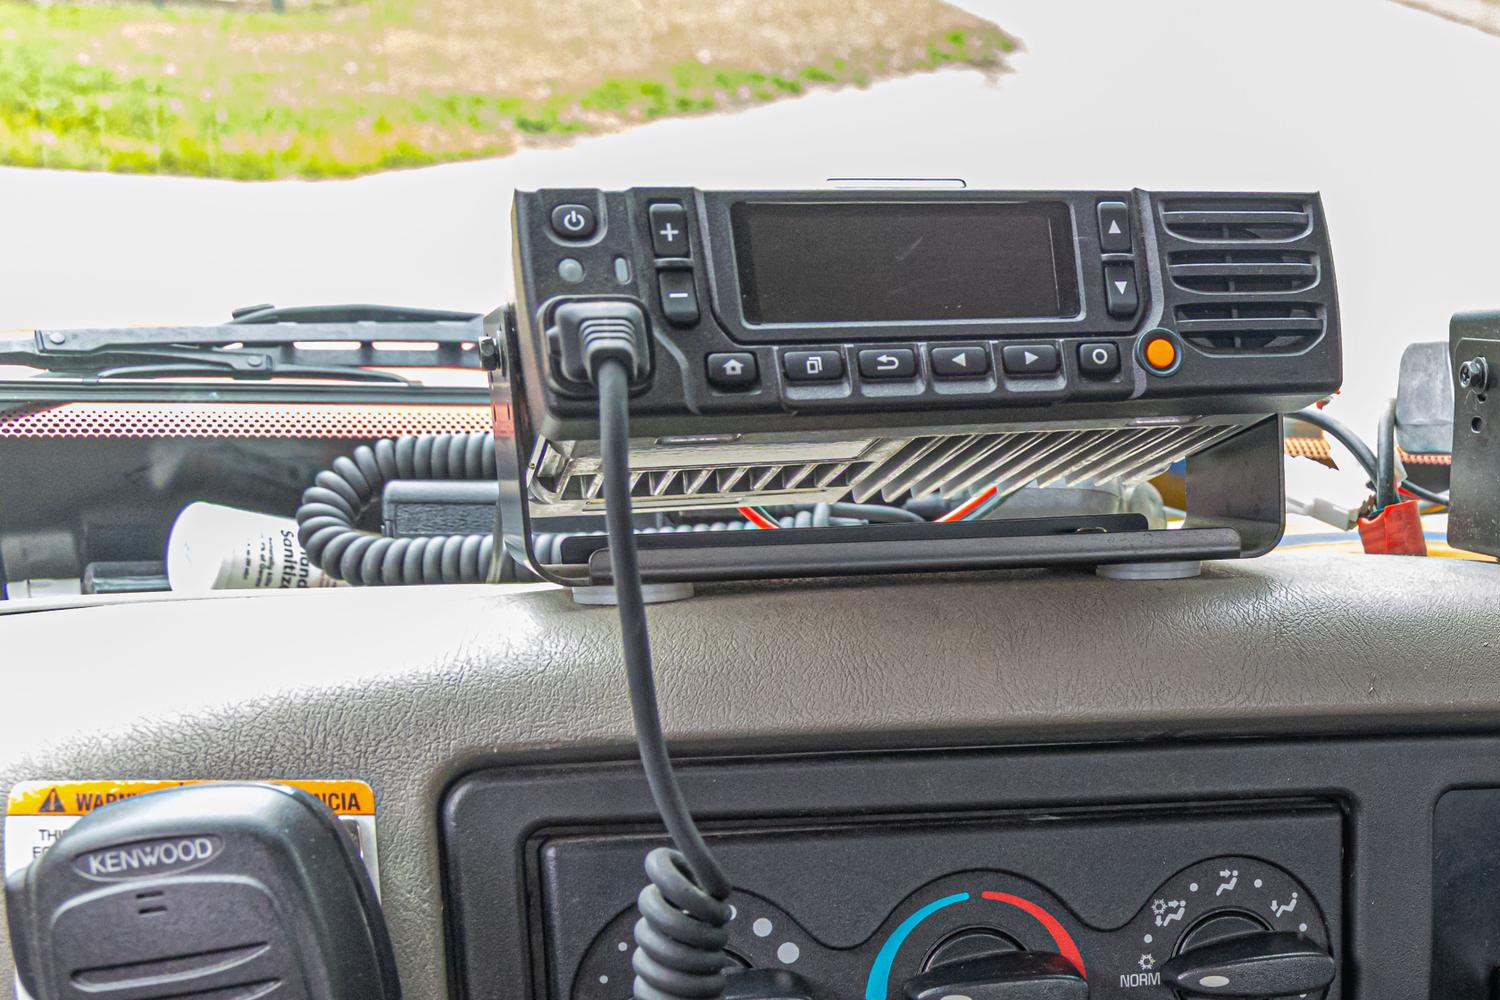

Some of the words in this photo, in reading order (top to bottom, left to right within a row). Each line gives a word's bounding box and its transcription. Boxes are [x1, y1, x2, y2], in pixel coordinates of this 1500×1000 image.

[296, 552, 310, 588] and
[89, 837, 213, 875] KENWOOD
[1120, 972, 1161, 988] NORM
